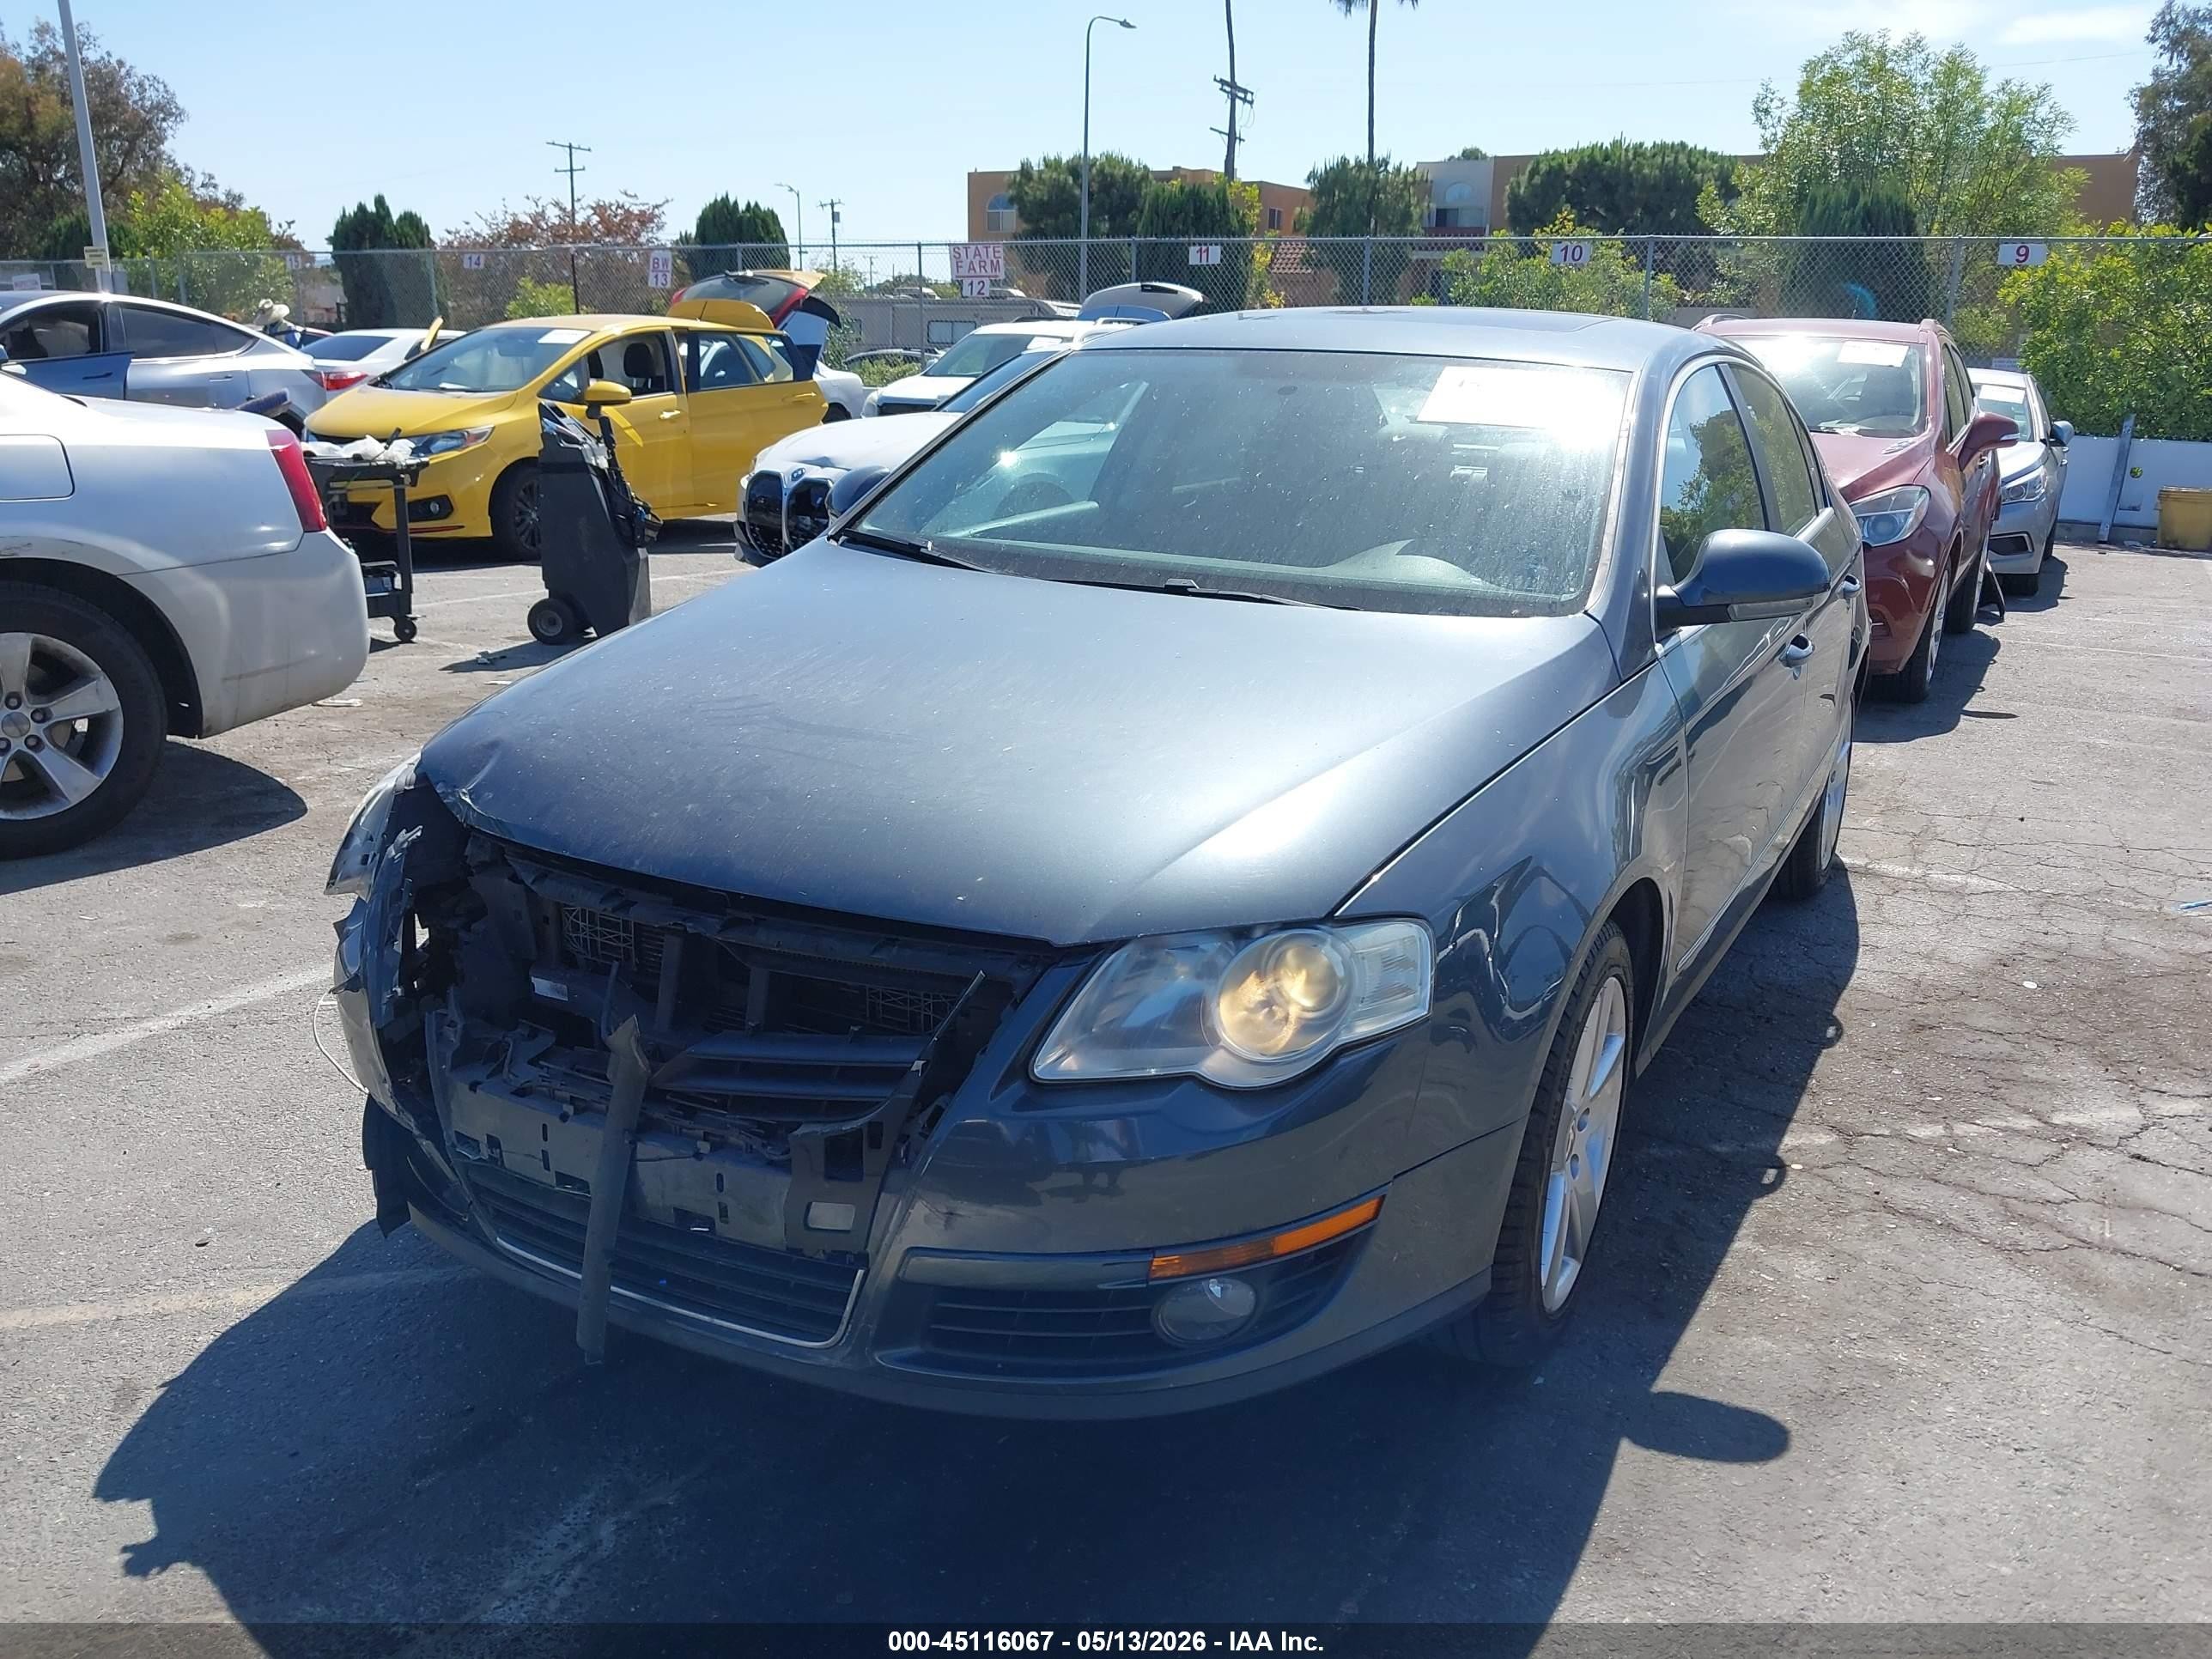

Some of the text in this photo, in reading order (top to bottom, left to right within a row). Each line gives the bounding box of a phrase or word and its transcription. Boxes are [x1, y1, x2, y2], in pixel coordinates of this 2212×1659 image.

[952, 246, 1002, 259] STATE
[1196, 246, 1209, 263] 11
[1560, 245, 1583, 262] 10
[2015, 245, 2030, 264] 9
[468, 255, 481, 268] 14
[955, 259, 1000, 274] FARM
[653, 274, 668, 287] 13
[968, 280, 986, 296] 12
